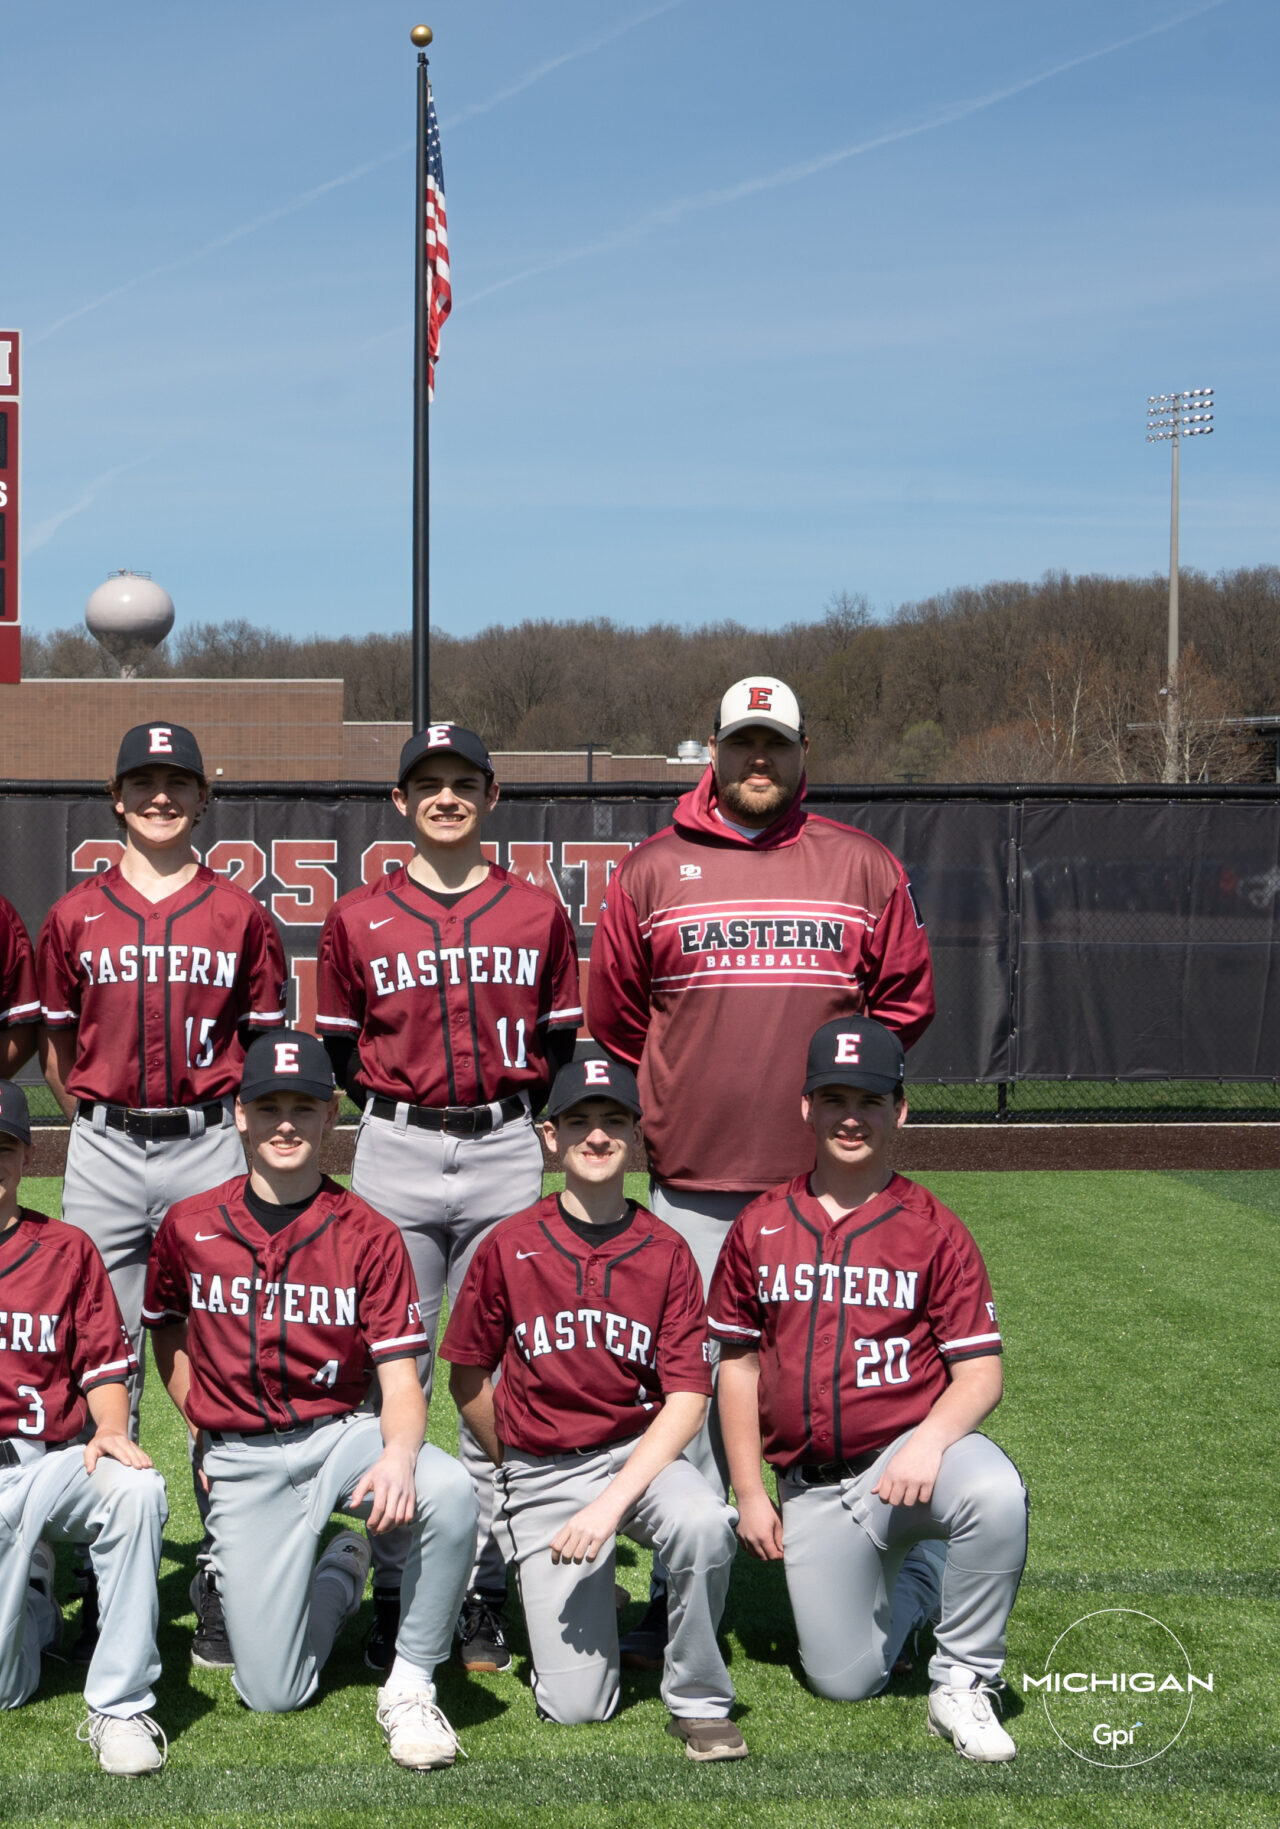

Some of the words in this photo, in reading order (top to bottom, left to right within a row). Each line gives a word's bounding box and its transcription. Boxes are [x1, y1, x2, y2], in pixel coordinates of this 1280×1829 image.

[747, 687, 773, 711] E
[149, 728, 173, 754] E
[427, 725, 452, 749] E
[678, 920, 845, 955] EASTERN
[370, 945, 540, 996] EASTERN
[706, 954, 820, 968] BASEBALL
[185, 1016, 217, 1068] 15
[274, 1043, 300, 1074] E
[496, 1017, 528, 1069] 11
[834, 1033, 861, 1064] E
[583, 1059, 610, 1086] E
[189, 1272, 357, 1326] EASTERN
[854, 1337, 912, 1388] 20
[17, 1384, 46, 1435] 3
